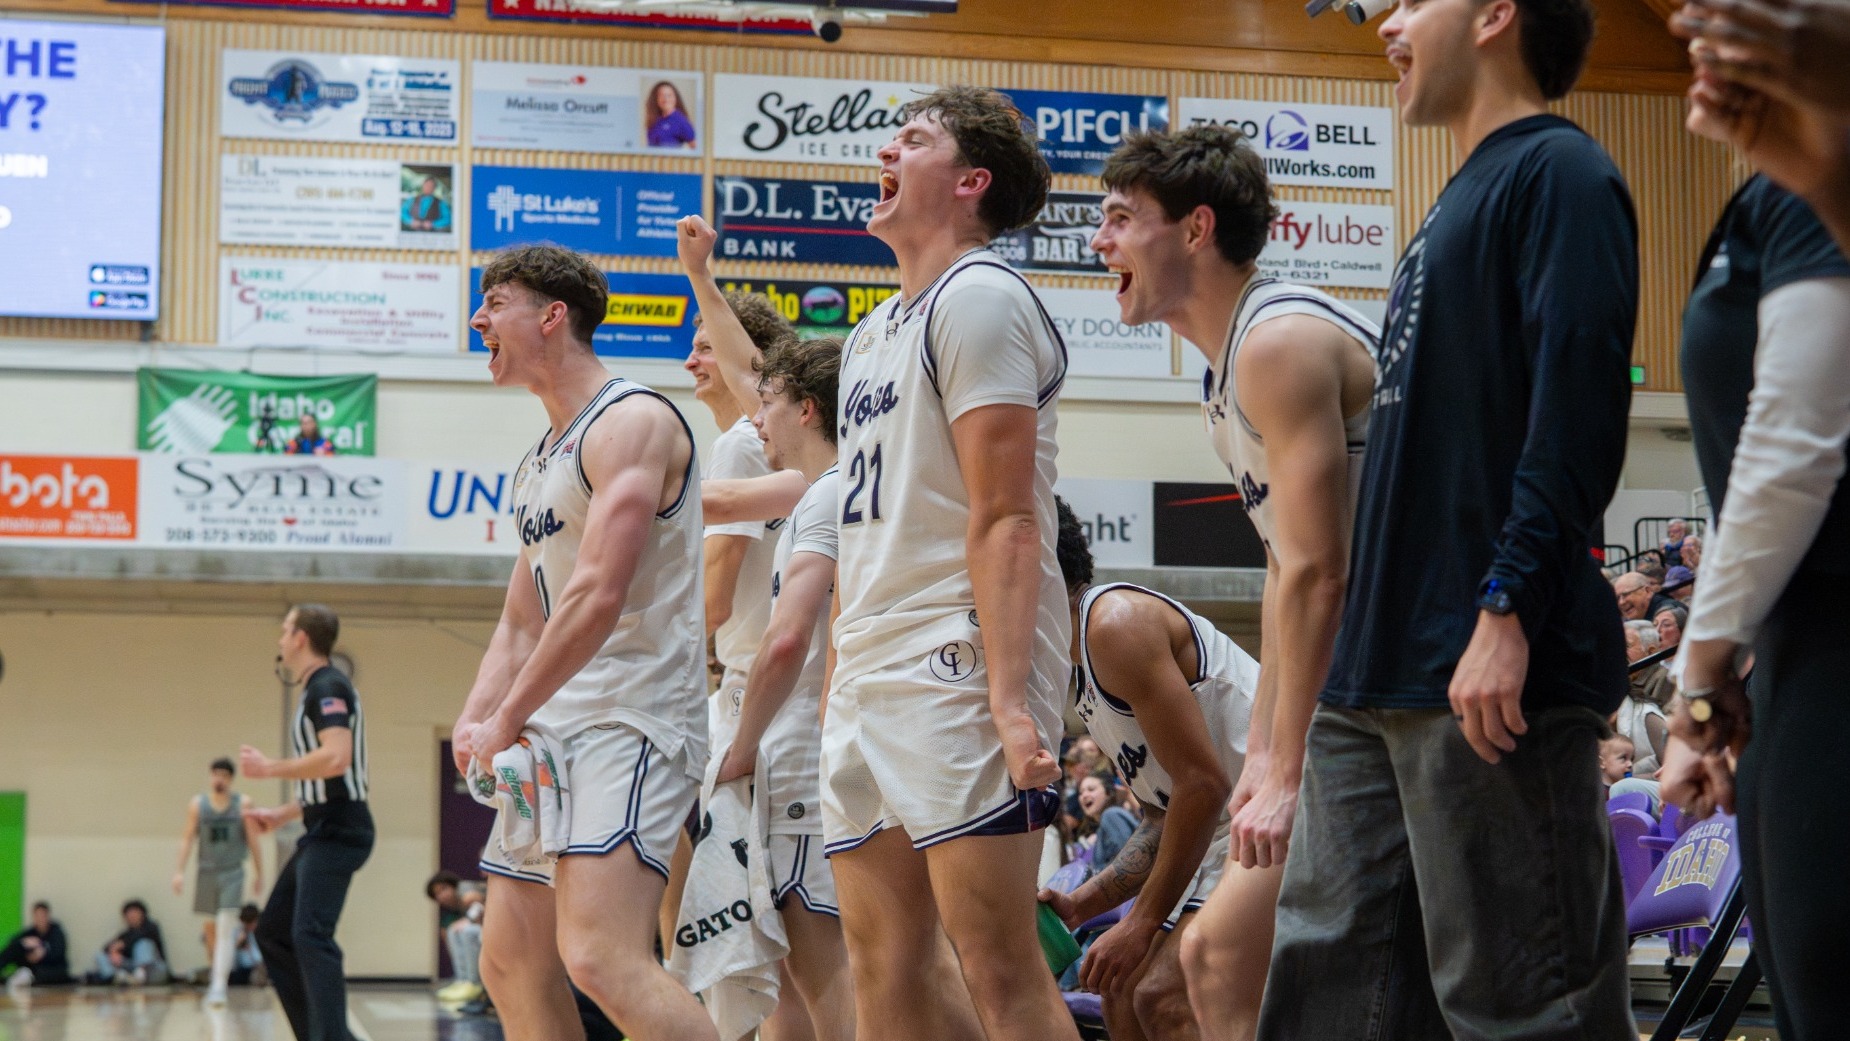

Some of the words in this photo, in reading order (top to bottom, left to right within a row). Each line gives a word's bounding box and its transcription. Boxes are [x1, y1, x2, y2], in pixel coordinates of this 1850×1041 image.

[0, 39, 76, 78] HE
[505, 98, 559, 113] Melissa
[563, 99, 609, 115] Orcutt
[1316, 124, 1377, 146] BELL
[799, 142, 828, 156] ICE
[841, 144, 884, 158] CRE
[722, 180, 803, 219] D.L.
[811, 184, 876, 222] Eva
[1317, 213, 1384, 246] lube
[723, 238, 797, 258] BANK
[1033, 236, 1079, 262] BAR
[1294, 259, 1321, 269] Blvd
[1330, 260, 1383, 271] Caldwell
[238, 286, 387, 305] CONSTRUCTION
[606, 302, 678, 317] CHWAB
[1082, 323, 1163, 343] DOORN
[248, 390, 336, 421] Idaho
[173, 457, 384, 510] Syme
[427, 468, 514, 520] UN
[841, 441, 884, 528] 21
[1653, 838, 1731, 897] IDAHO
[675, 899, 752, 948] GATO
